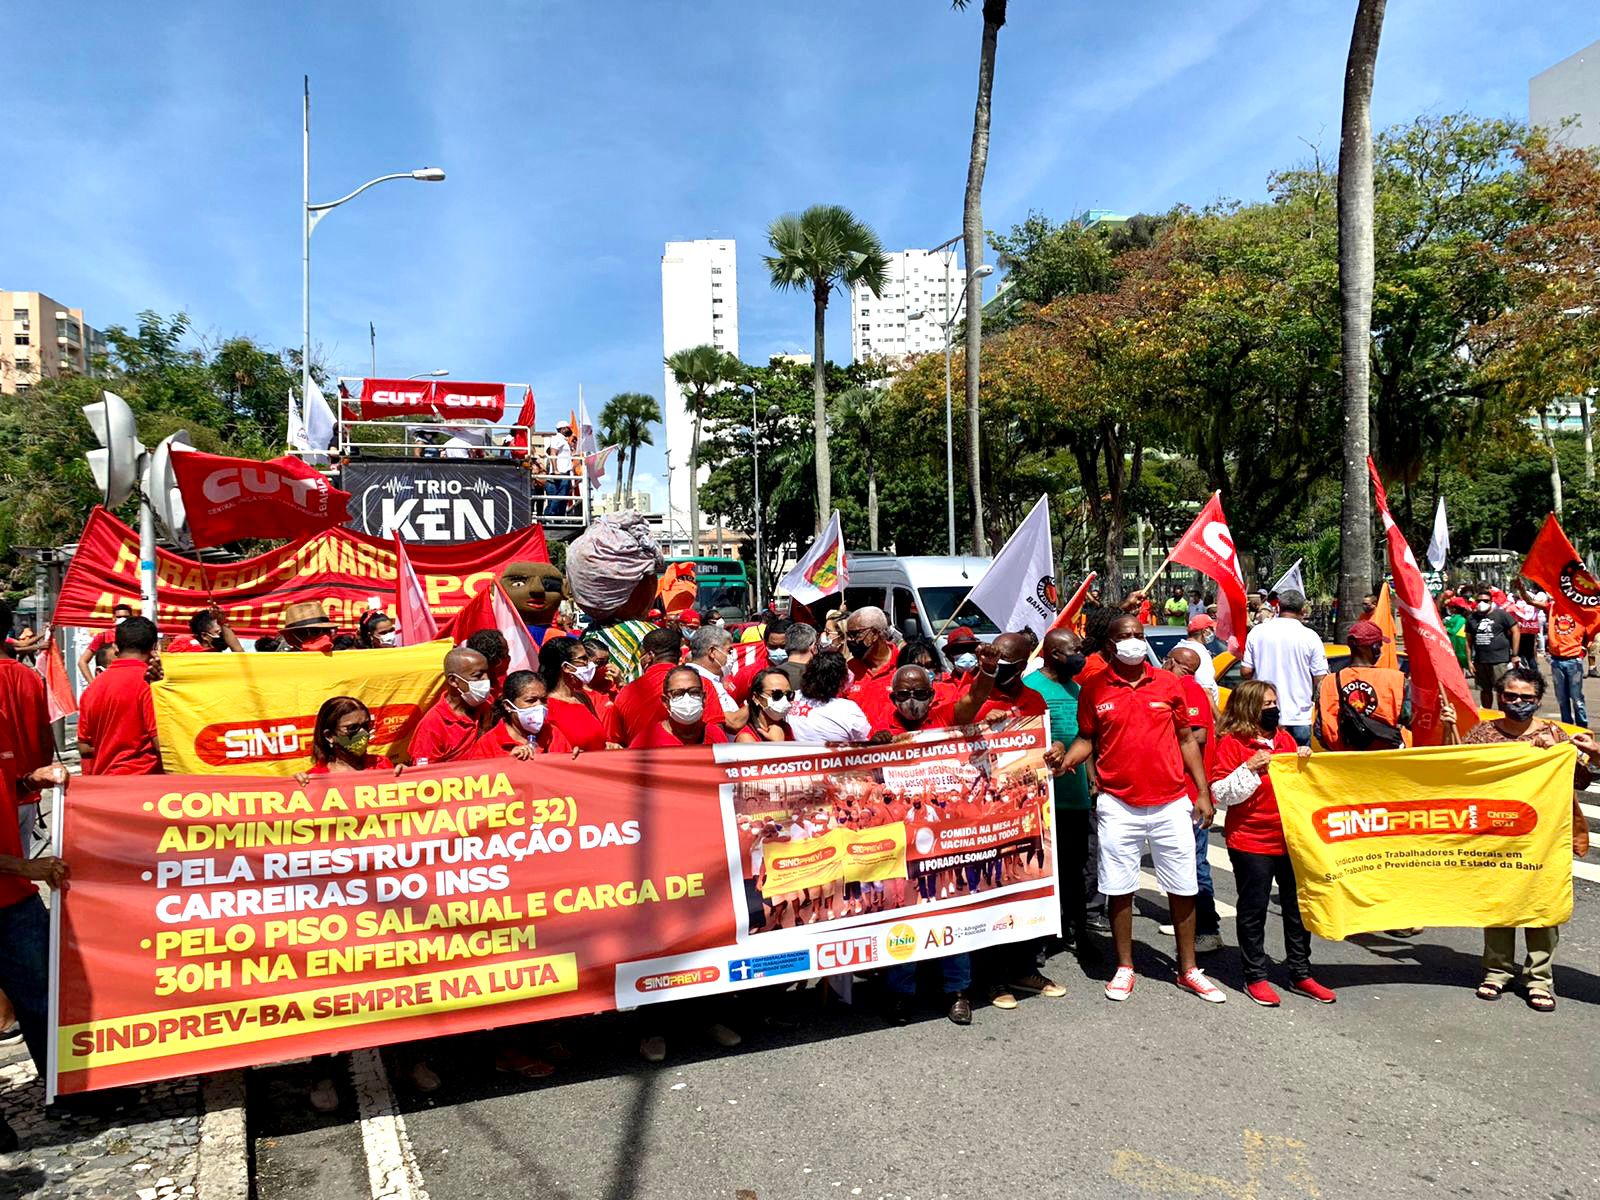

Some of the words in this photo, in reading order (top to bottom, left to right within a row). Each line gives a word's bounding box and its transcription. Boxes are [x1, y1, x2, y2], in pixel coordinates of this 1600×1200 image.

[371, 390, 421, 405] CUT
[443, 393, 491, 407] CUT
[202, 467, 318, 507] CUT
[316, 477, 329, 512] BAHIA
[414, 480, 462, 495] TRIO
[381, 498, 495, 541] KEN
[1026, 595, 1048, 619] BAHIA
[725, 767, 739, 779] 18
[741, 766, 758, 778] DE
[761, 760, 812, 775] AGOSTO
[821, 757, 843, 769] DIA
[845, 751, 904, 766] NACIONAL
[906, 747, 921, 759] DE
[922, 744, 956, 757] LUTAS
[958, 743, 966, 753] E
[968, 734, 1036, 752] PARALISAÇÃO
[157, 790, 313, 819] CONTRA
[321, 787, 348, 812] A
[355, 772, 514, 809] REFORMA
[532, 796, 577, 827] 32)
[940, 826, 977, 839] COMIDA
[979, 824, 991, 835] NA
[992, 820, 1011, 833] MESA
[1322, 807, 1469, 837] SINDPREV
[1487, 811, 1519, 819] CNTSS
[157, 856, 255, 889] PELA
[264, 822, 572, 881] REESTRUTURAÇÃO
[579, 820, 641, 850] DAS
[940, 838, 975, 850] VACINA
[977, 834, 997, 846] PARA
[998, 827, 1019, 841] TODOS
[1365, 853, 1382, 861] dos
[1385, 848, 1454, 859] Trabalhadores
[1457, 849, 1503, 858] Federais
[1385, 860, 1441, 869] Previdência
[1444, 859, 1457, 867] do
[1460, 859, 1497, 868] Estado
[156, 880, 367, 924] CARREIRAS
[376, 872, 428, 903] DO
[436, 864, 510, 896] INSS
[156, 923, 256, 960] PELO
[265, 913, 348, 949] PISO
[356, 896, 523, 938] SALARIAL
[528, 892, 547, 917] E
[553, 878, 661, 912] CARGA
[666, 872, 706, 900] DE
[155, 960, 231, 996] 30H
[242, 954, 298, 985] NA
[306, 925, 537, 978] ENFERMAGEM
[818, 937, 871, 970] CUT
[72, 1001, 305, 1057] SINDPREV-BA
[313, 982, 433, 1020] SEMPRE
[440, 973, 482, 998] NA
[490, 963, 559, 994] LUTA
